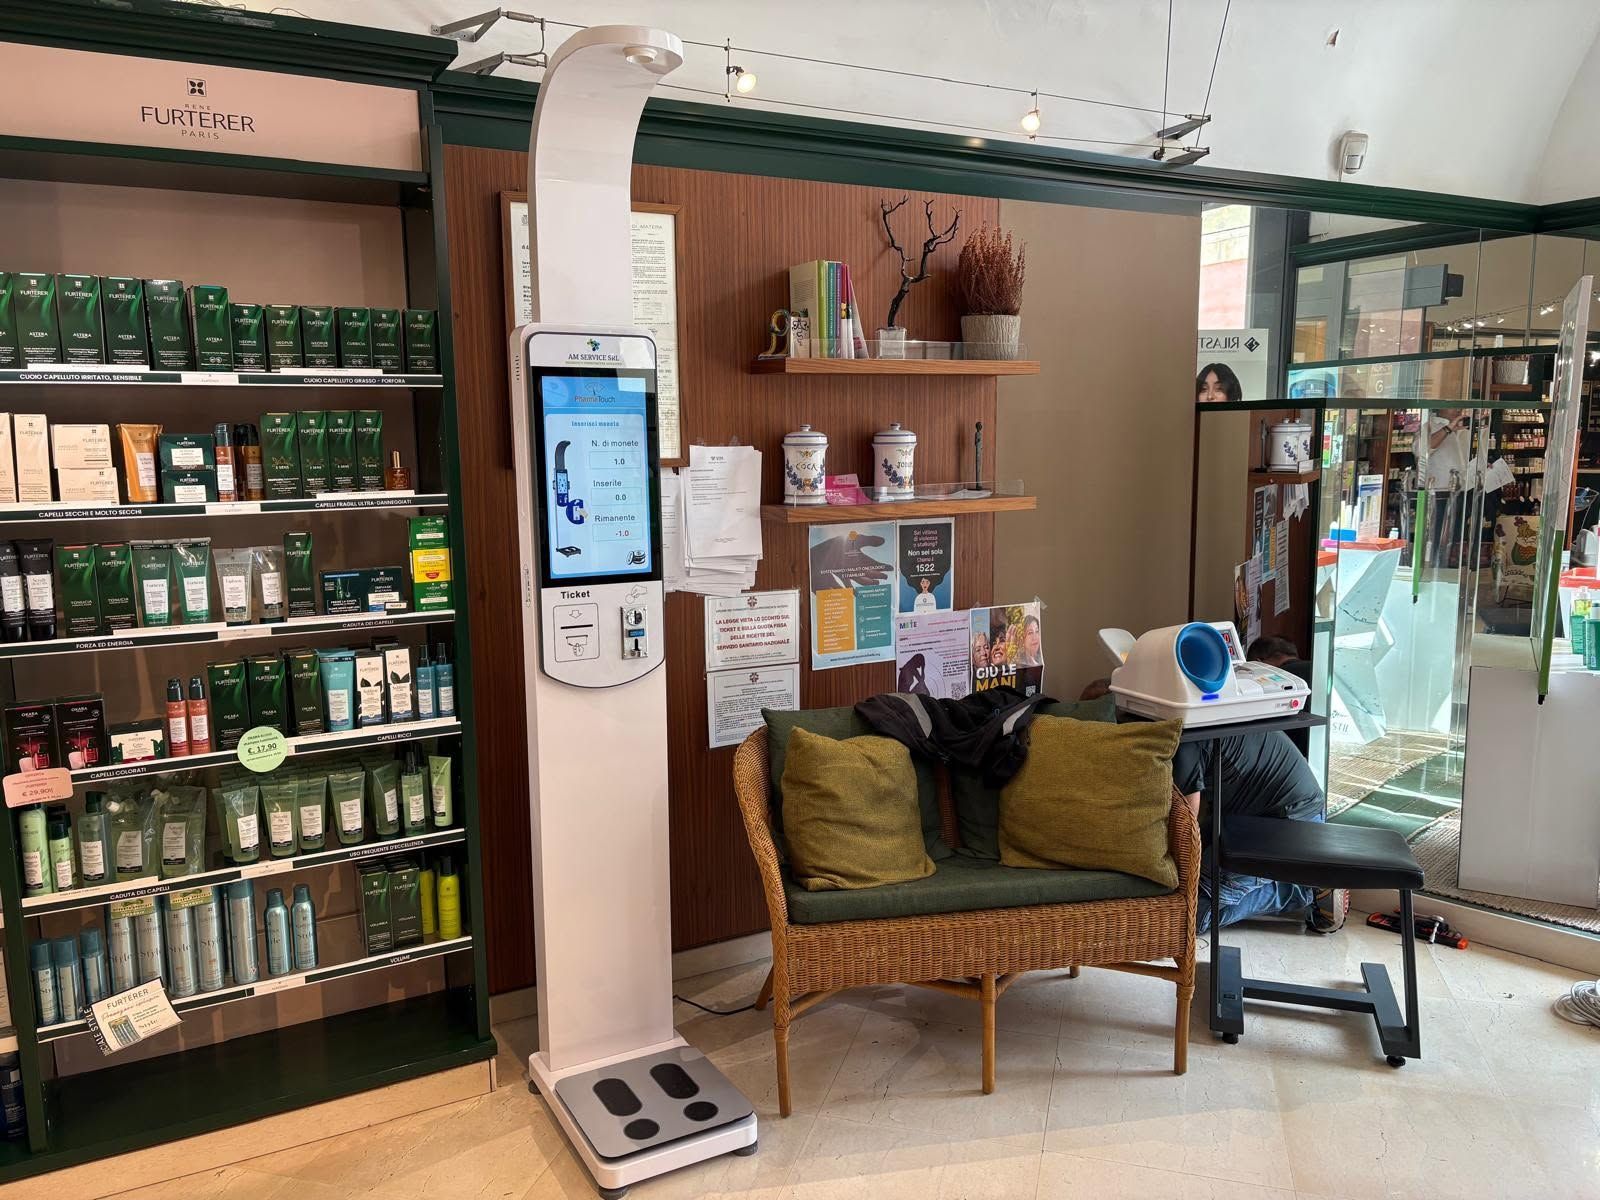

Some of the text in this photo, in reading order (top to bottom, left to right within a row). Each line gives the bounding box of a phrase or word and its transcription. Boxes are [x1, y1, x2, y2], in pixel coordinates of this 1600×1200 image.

[141, 106, 255, 132] FURTERER
[182, 130, 220, 140] PARIS
[796, 462, 818, 472] COCA
[916, 564, 935, 572] 1522
[561, 590, 590, 599] Ticket
[976, 664, 998, 679] GIÙ
[1001, 664, 1017, 676] LE
[976, 676, 1016, 692] MANI
[258, 743, 277, 753] 17,90
[115, 768, 146, 776] COLORATI
[362, 845, 389, 855] FREQUENTE
[390, 840, 424, 850] D'ECCELLENZA
[110, 891, 135, 900] CADUTA
[146, 886, 170, 894] CAPELLI
[390, 954, 411, 964] VOLUME
[106, 988, 149, 1010] FURTERER
[84, 1007, 99, 1032] STYLE
